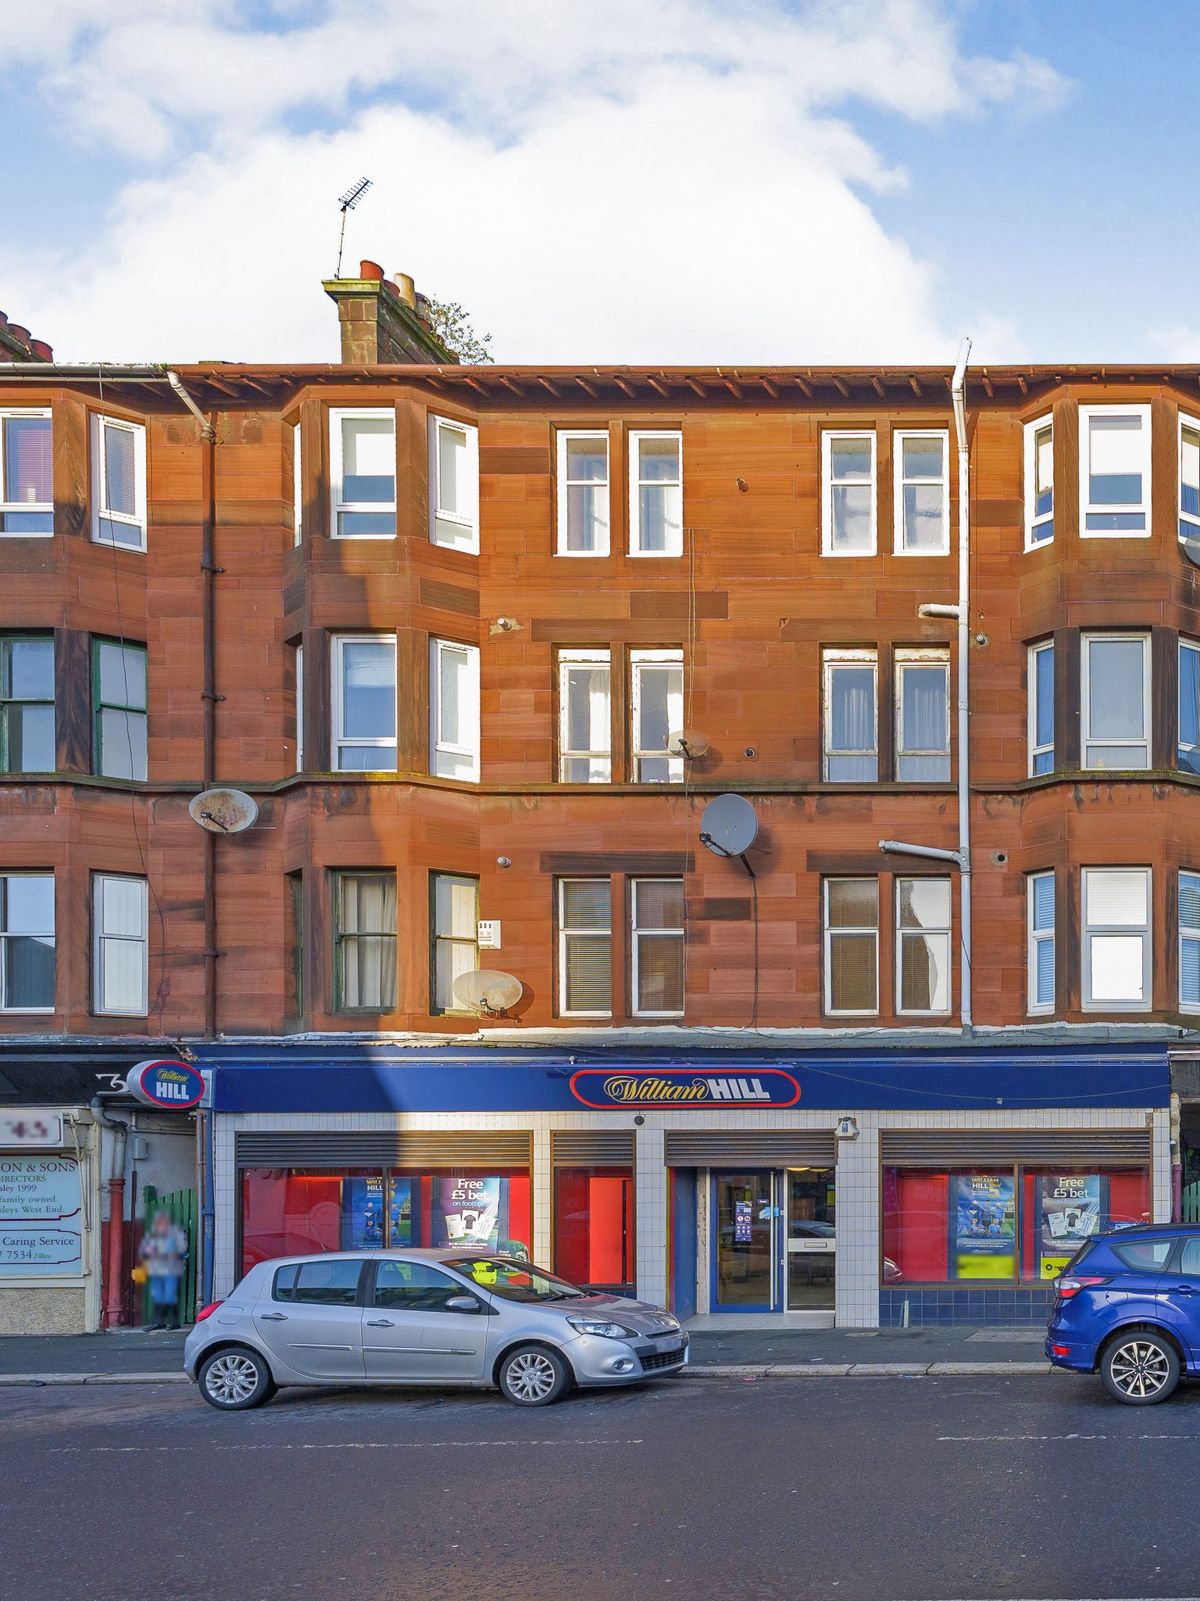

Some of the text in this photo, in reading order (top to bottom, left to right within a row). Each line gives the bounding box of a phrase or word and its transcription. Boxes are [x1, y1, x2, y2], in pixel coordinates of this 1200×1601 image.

[156, 1082, 190, 1100] HILL
[604, 1076, 770, 1102] William HILL
[26, 1162, 36, 1173] &
[40, 1162, 76, 1173] SONS
[458, 1178, 484, 1189] Free
[1060, 1177, 1085, 1187] Free
[17, 1184, 37, 1192] 1999
[1053, 1188, 1089, 1198] £5 bet
[451, 1189, 488, 1200] £5 bet
[0, 1195, 56, 1205] amily owned
[22, 1205, 42, 1213] West
[2, 1236, 75, 1247] Caring Service
[7, 1250, 32, 1259] 7534
